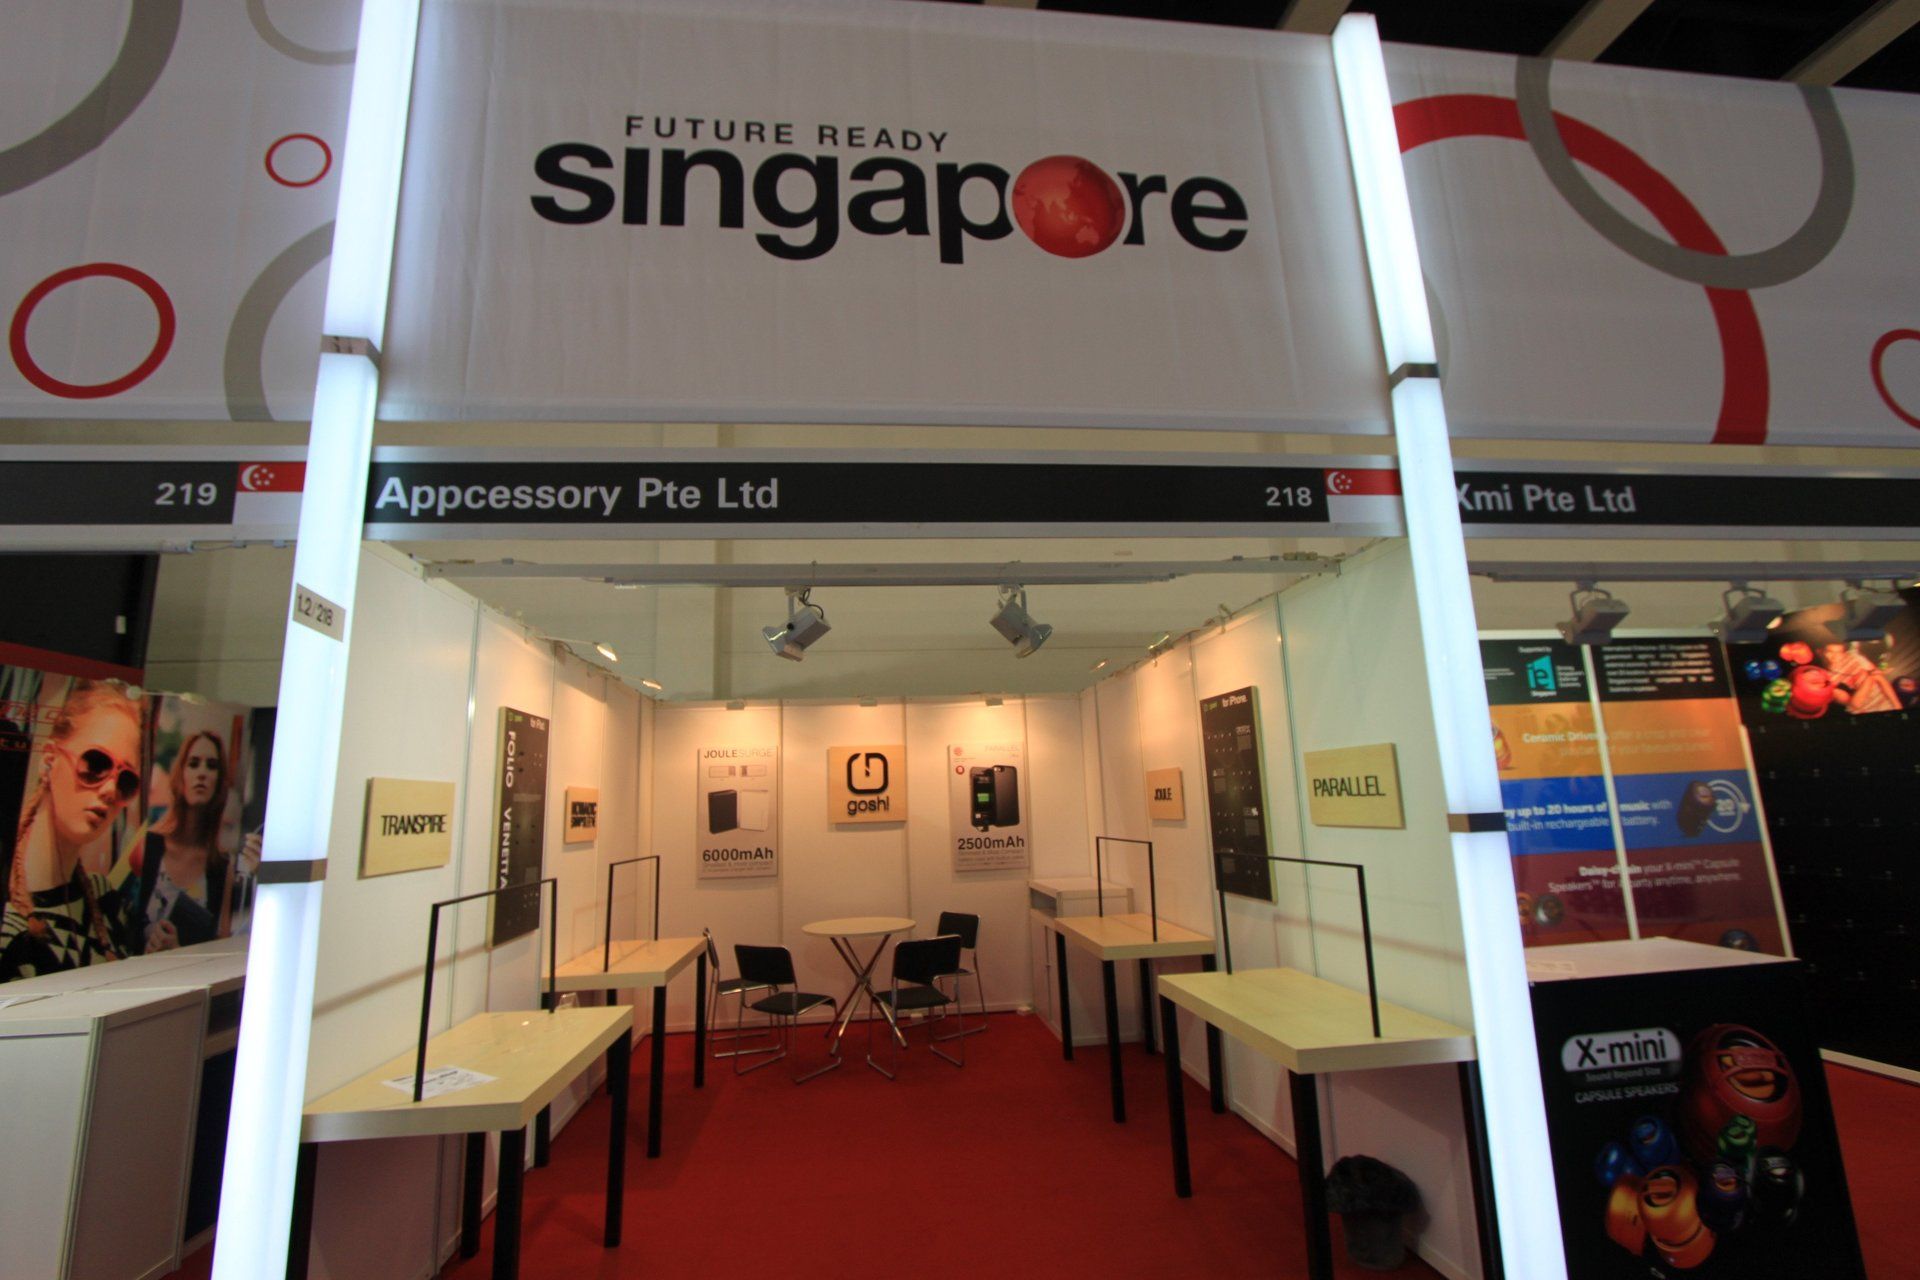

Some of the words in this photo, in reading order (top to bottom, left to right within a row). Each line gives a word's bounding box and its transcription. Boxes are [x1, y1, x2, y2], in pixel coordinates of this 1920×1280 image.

[625, 115, 794, 145] FUTURE
[817, 124, 949, 153] READY
[530, 141, 1249, 264] singapore
[155, 483, 218, 506] 219
[375, 476, 622, 517] Appcessory
[638, 477, 701, 508] Pte
[717, 477, 779, 509] Ltd
[1265, 486, 1313, 508] 218
[1522, 484, 1576, 512] Pte
[1584, 485, 1637, 513] Ltd
[505, 731, 516, 788] FOLIO
[1313, 775, 1386, 798] PARALLEL
[1518, 807, 1532, 818] up
[1533, 806, 1546, 816] to
[1547, 805, 1562, 815] 20
[1564, 803, 1593, 814] hours
[1594, 802, 1608, 812] of
[381, 814, 447, 836] TRANSPIRE
[1507, 819, 1543, 832] built-in
[702, 847, 774, 861] 6000mAh
[958, 835, 1025, 850] 2500mAh
[1575, 1030, 1667, 1068] X-mini
[1574, 1087, 1622, 1104] CAPSULE
[1624, 1081, 1679, 1098] SPEAKERS
